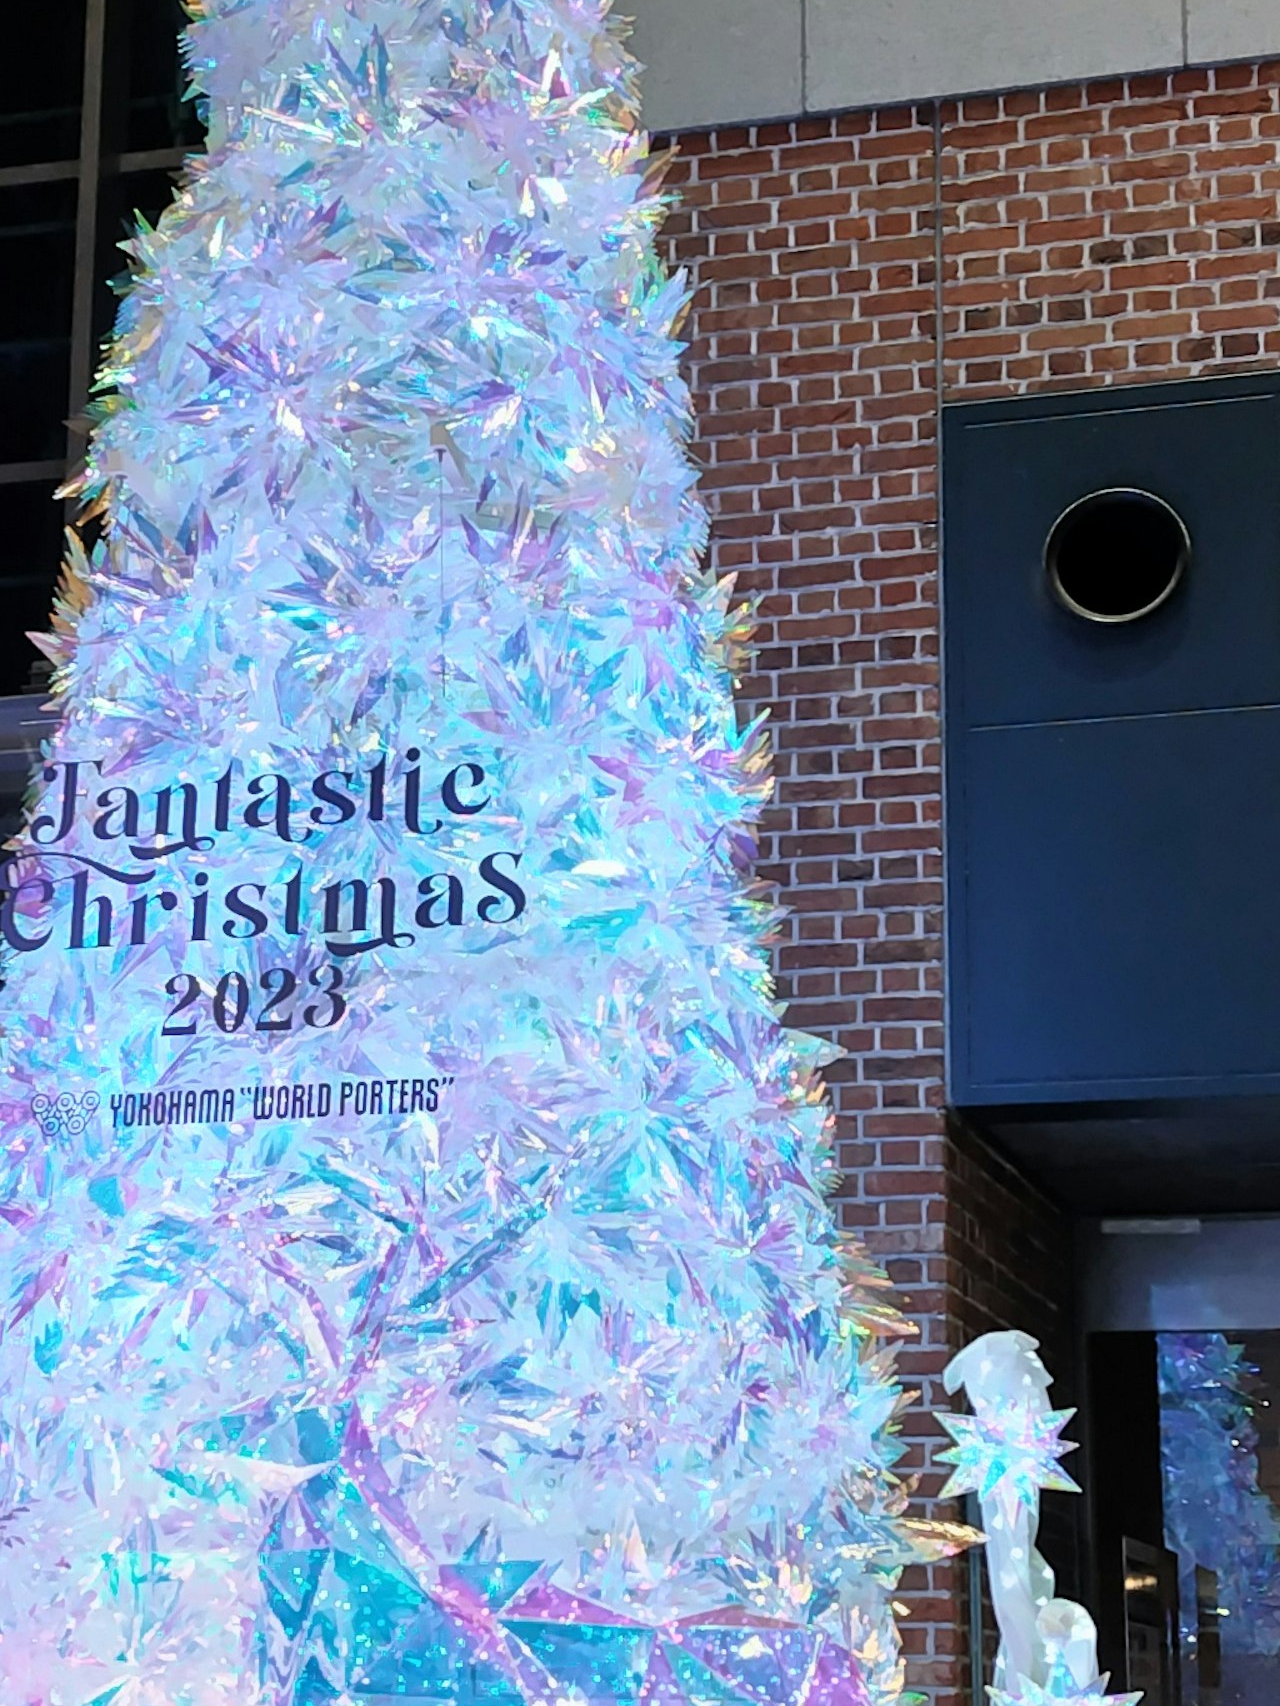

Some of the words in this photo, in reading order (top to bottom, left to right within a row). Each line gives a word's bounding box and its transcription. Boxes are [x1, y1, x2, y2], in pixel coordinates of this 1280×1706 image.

[30, 747, 491, 860] Fantastic
[160, 964, 349, 1037] 2023
[109, 1088, 235, 1129] YOKOHAMA
